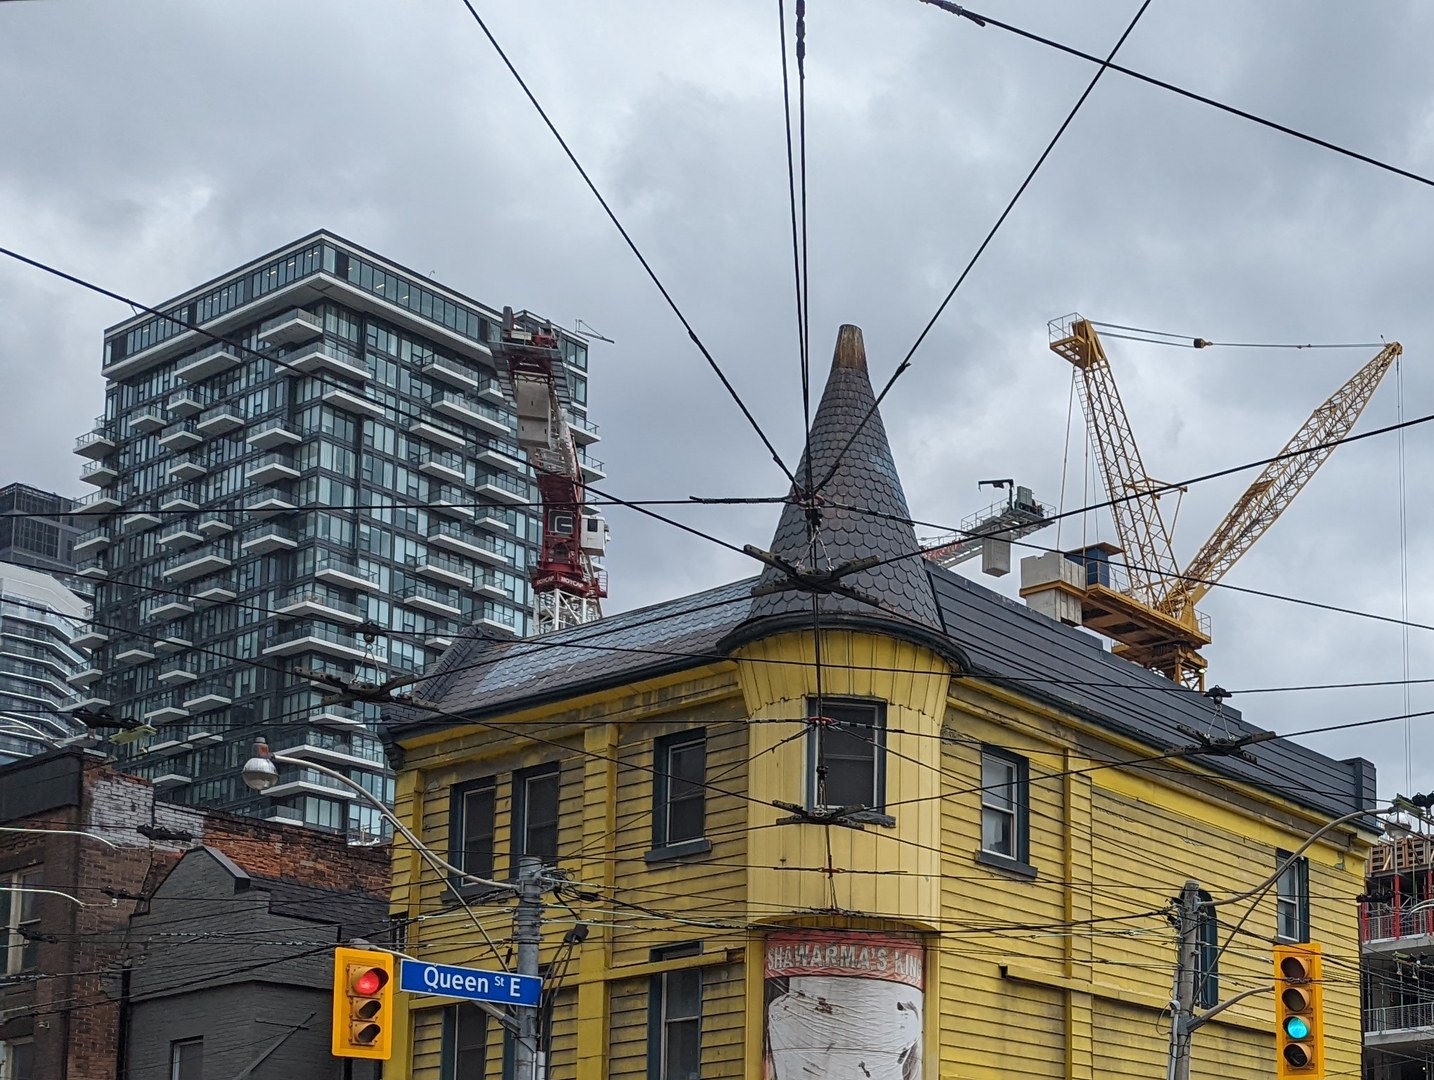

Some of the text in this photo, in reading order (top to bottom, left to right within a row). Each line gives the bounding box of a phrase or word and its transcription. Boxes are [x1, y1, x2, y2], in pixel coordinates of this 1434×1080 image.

[767, 942, 888, 971] SHAWARMA'S
[423, 966, 521, 997] Queen St E
